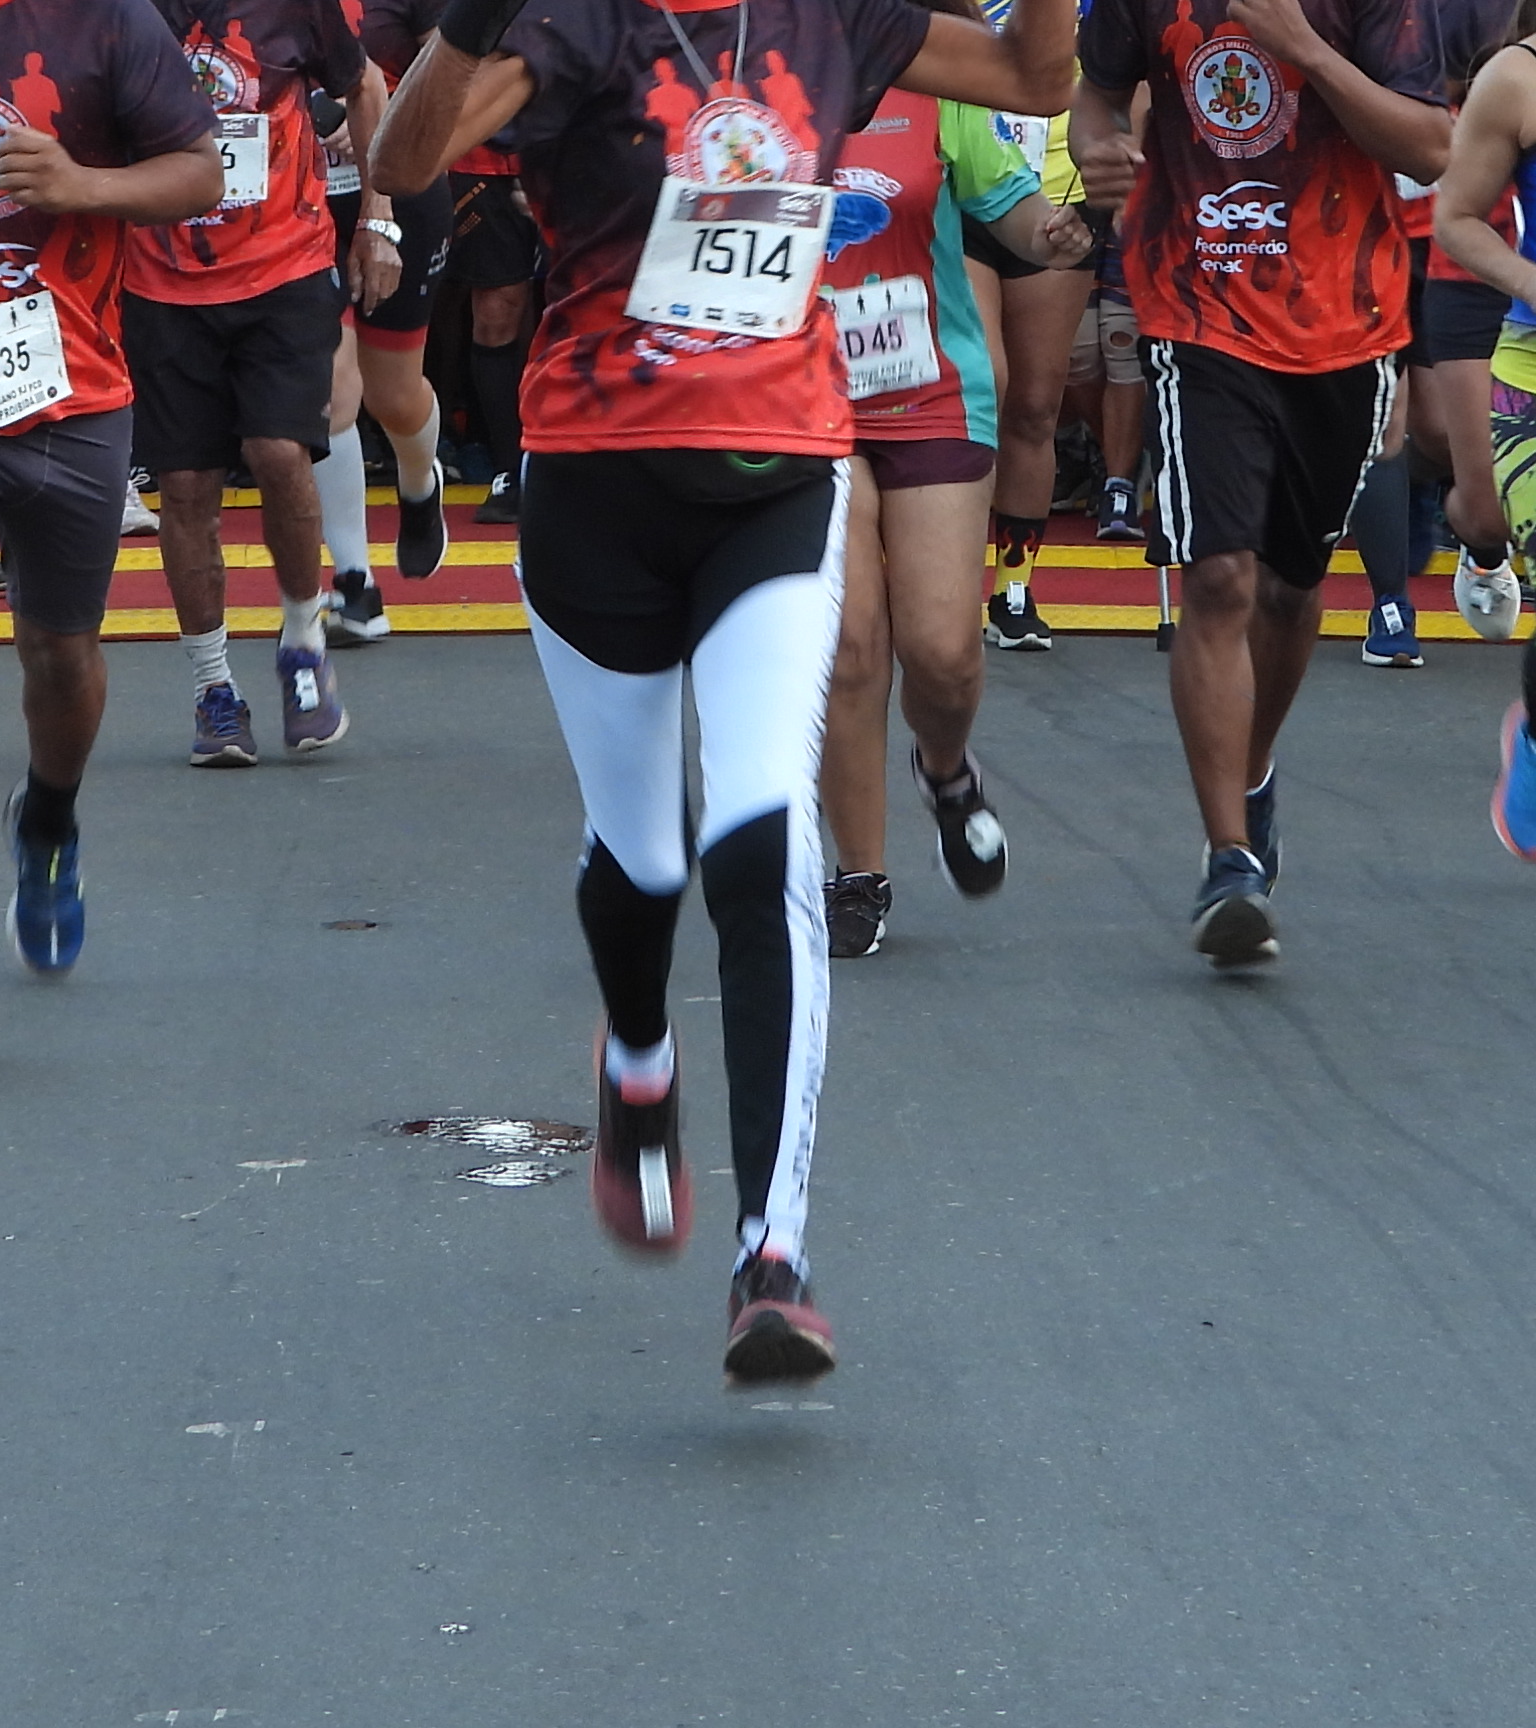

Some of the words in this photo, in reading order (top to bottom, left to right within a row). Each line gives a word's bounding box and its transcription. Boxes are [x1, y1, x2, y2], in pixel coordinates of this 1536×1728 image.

[1196, 180, 1287, 230] Sesc
[689, 228, 794, 283] 1514
[1195, 236, 1288, 254] Fecomércio
[1197, 256, 1244, 273] enac
[0, 339, 31, 378] 35
